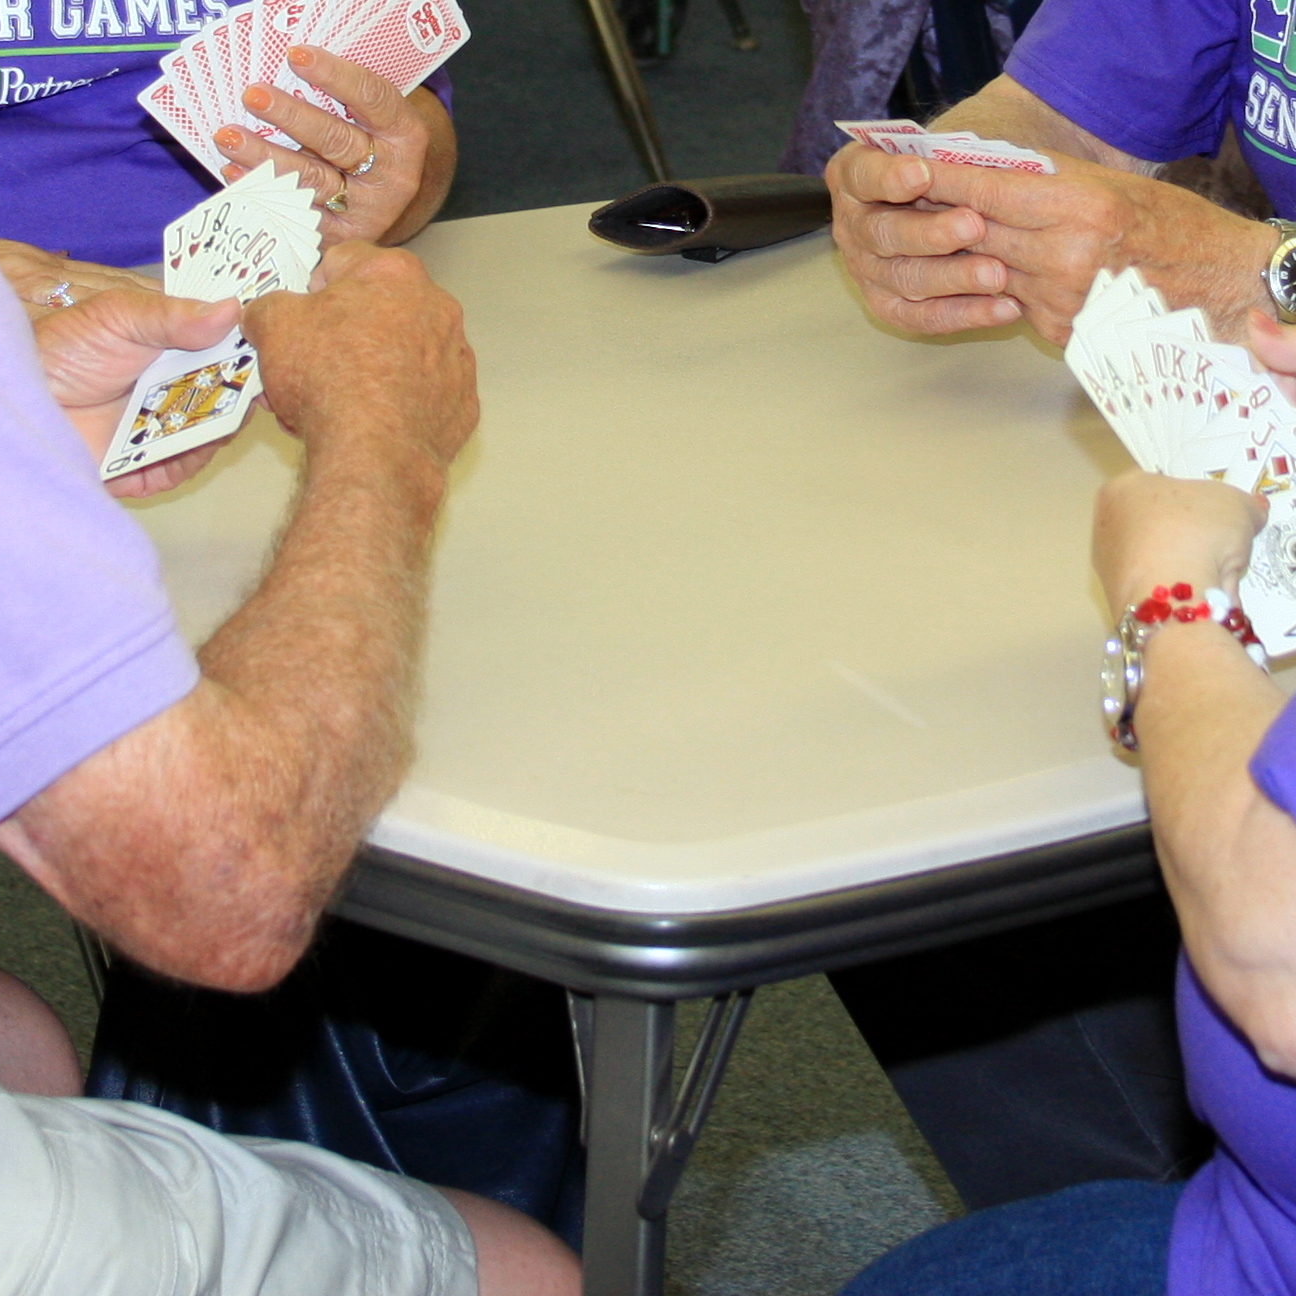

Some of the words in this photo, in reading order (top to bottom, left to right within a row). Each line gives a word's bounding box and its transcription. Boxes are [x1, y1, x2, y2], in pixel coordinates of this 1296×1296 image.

[168, 225, 185, 256] J
[191, 208, 212, 240] J
[1104, 353, 1124, 389] A
[1131, 350, 1149, 385] A
[1170, 343, 1186, 383] K
[1193, 351, 1214, 392] K
[1083, 369, 1107, 403] A
[1249, 385, 1272, 409] Q
[1250, 421, 1277, 446] J
